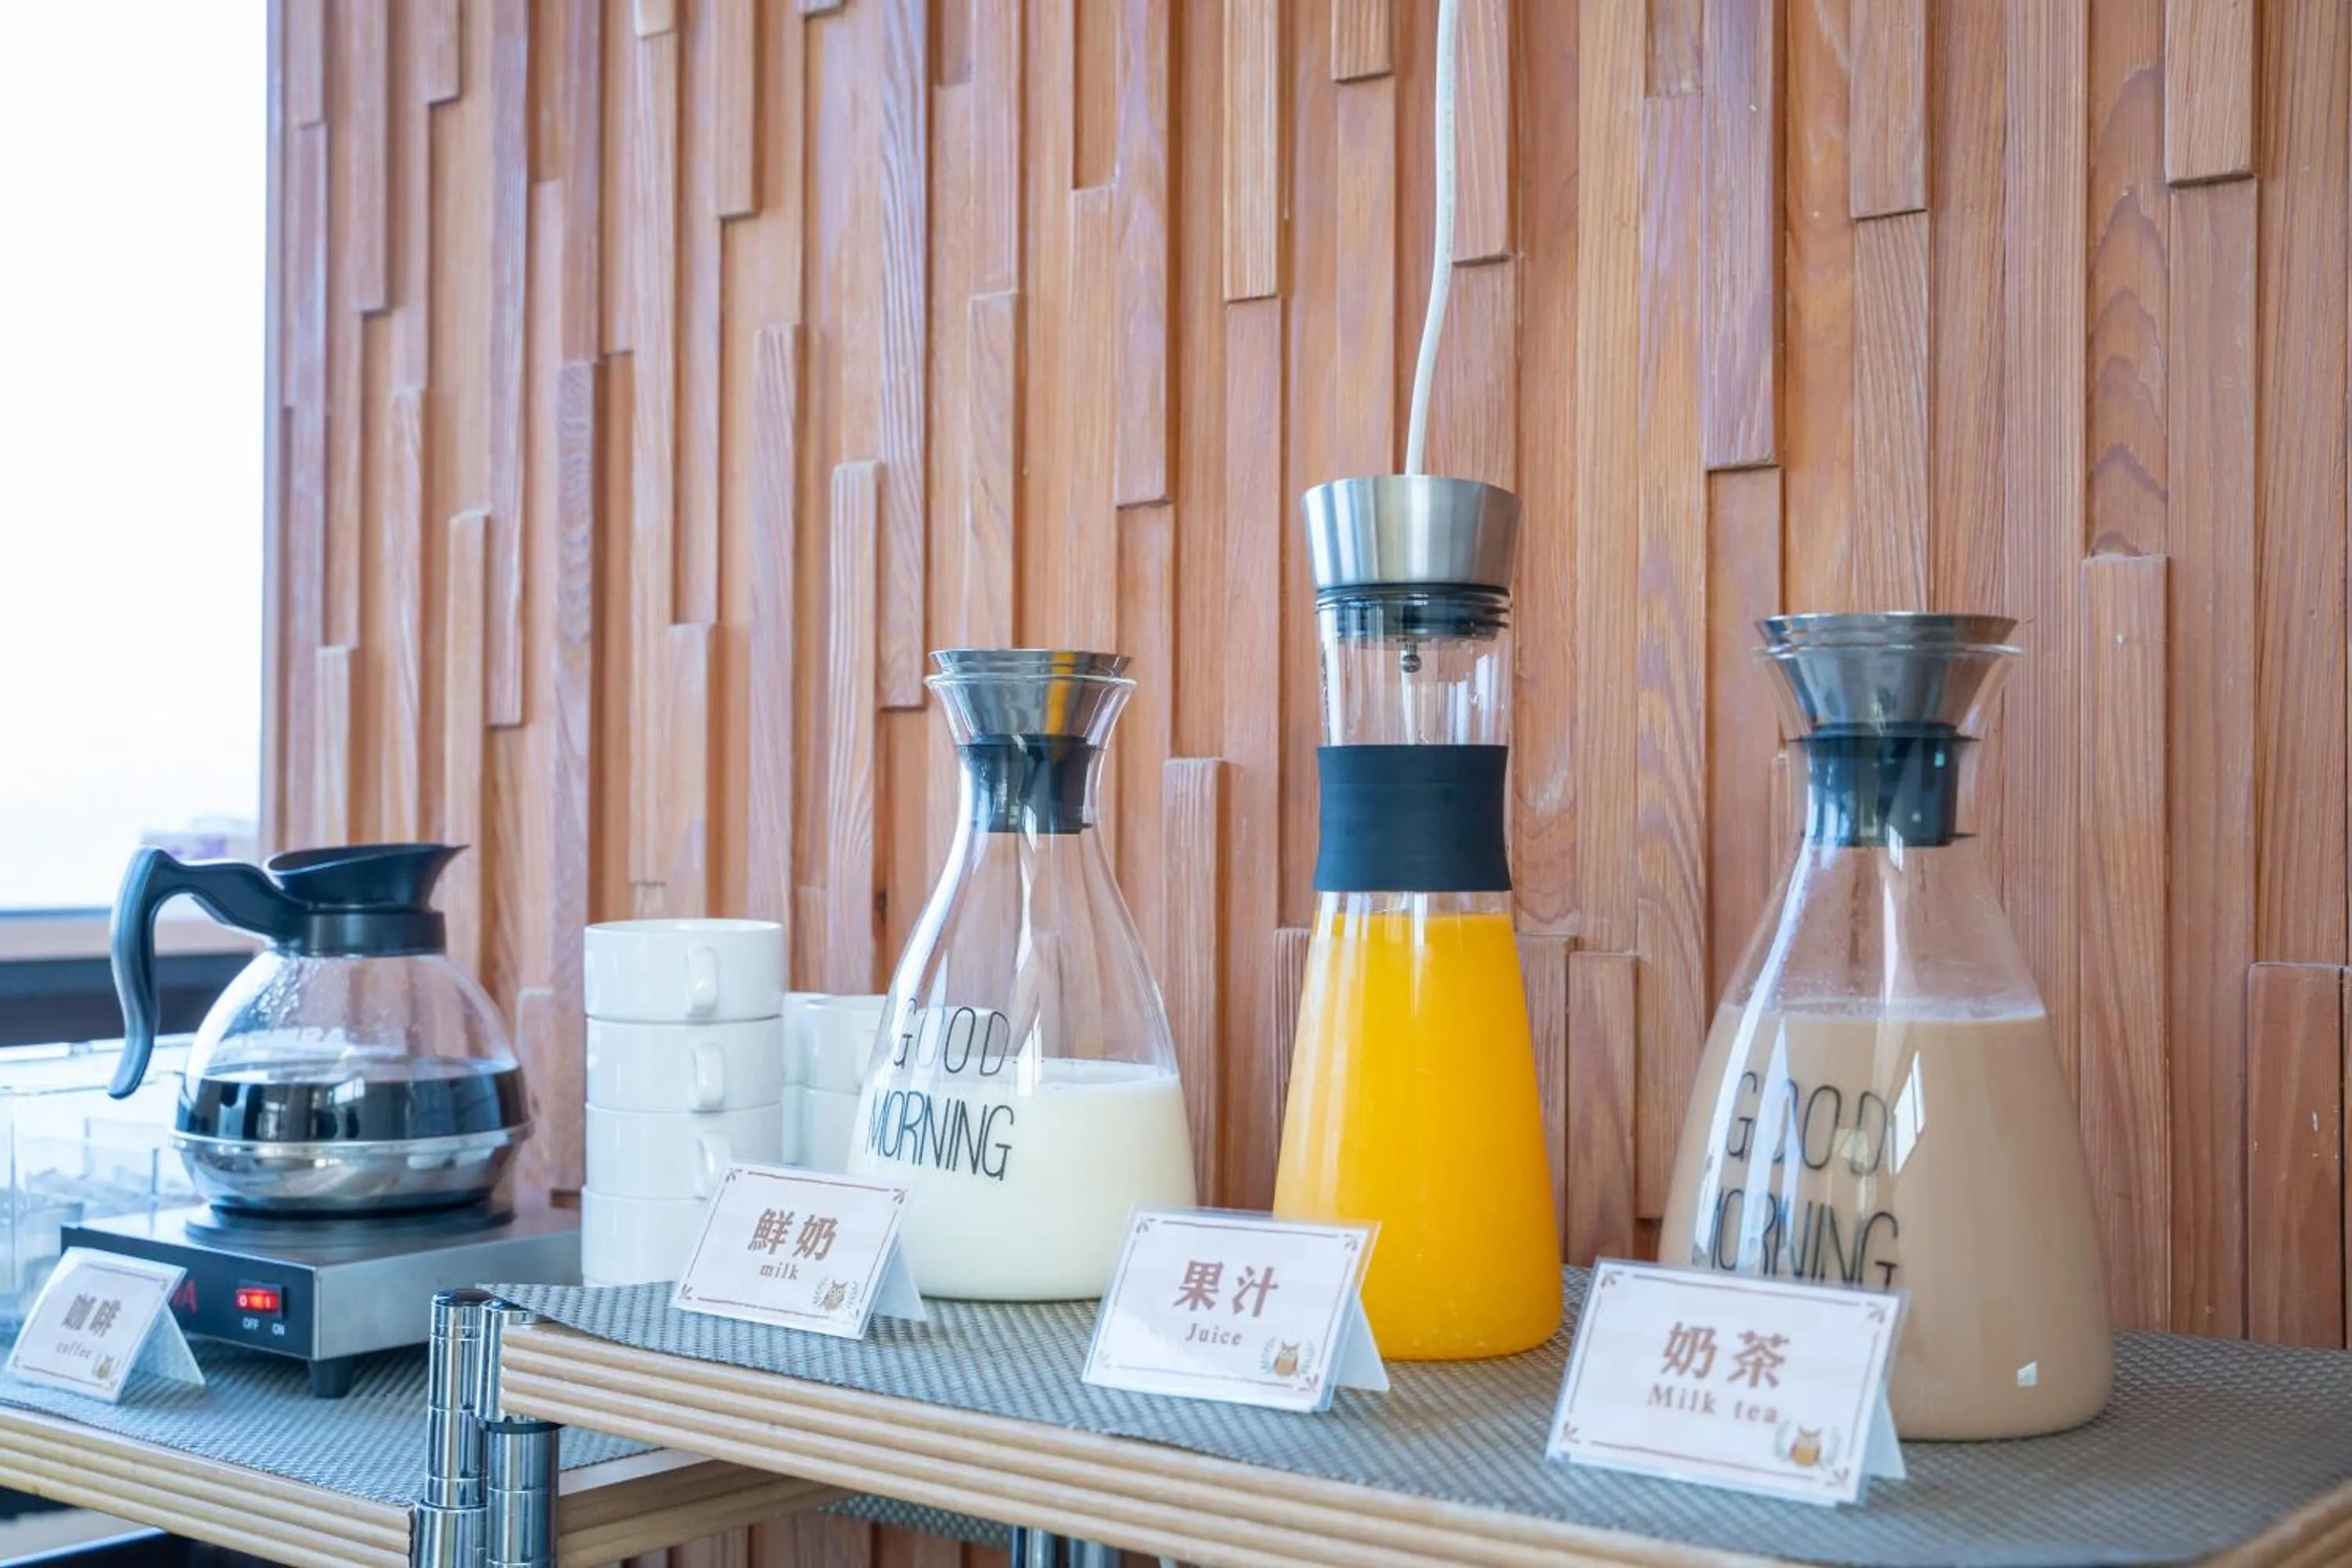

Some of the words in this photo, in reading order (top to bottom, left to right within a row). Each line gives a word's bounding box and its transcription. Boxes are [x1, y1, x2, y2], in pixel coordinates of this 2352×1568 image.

[866, 1090, 1014, 1181] MORNING
[747, 1207, 839, 1261] 鮮奶
[759, 1261, 800, 1281] milk
[1172, 1259, 1279, 1318] 果汁
[242, 1316, 260, 1330] OFF
[271, 1323, 285, 1336] ON
[1185, 1322, 1243, 1348] Juice
[1659, 1320, 1791, 1390] 奶茶
[1646, 1383, 1717, 1417] Milk
[1733, 1398, 1779, 1425] tea
